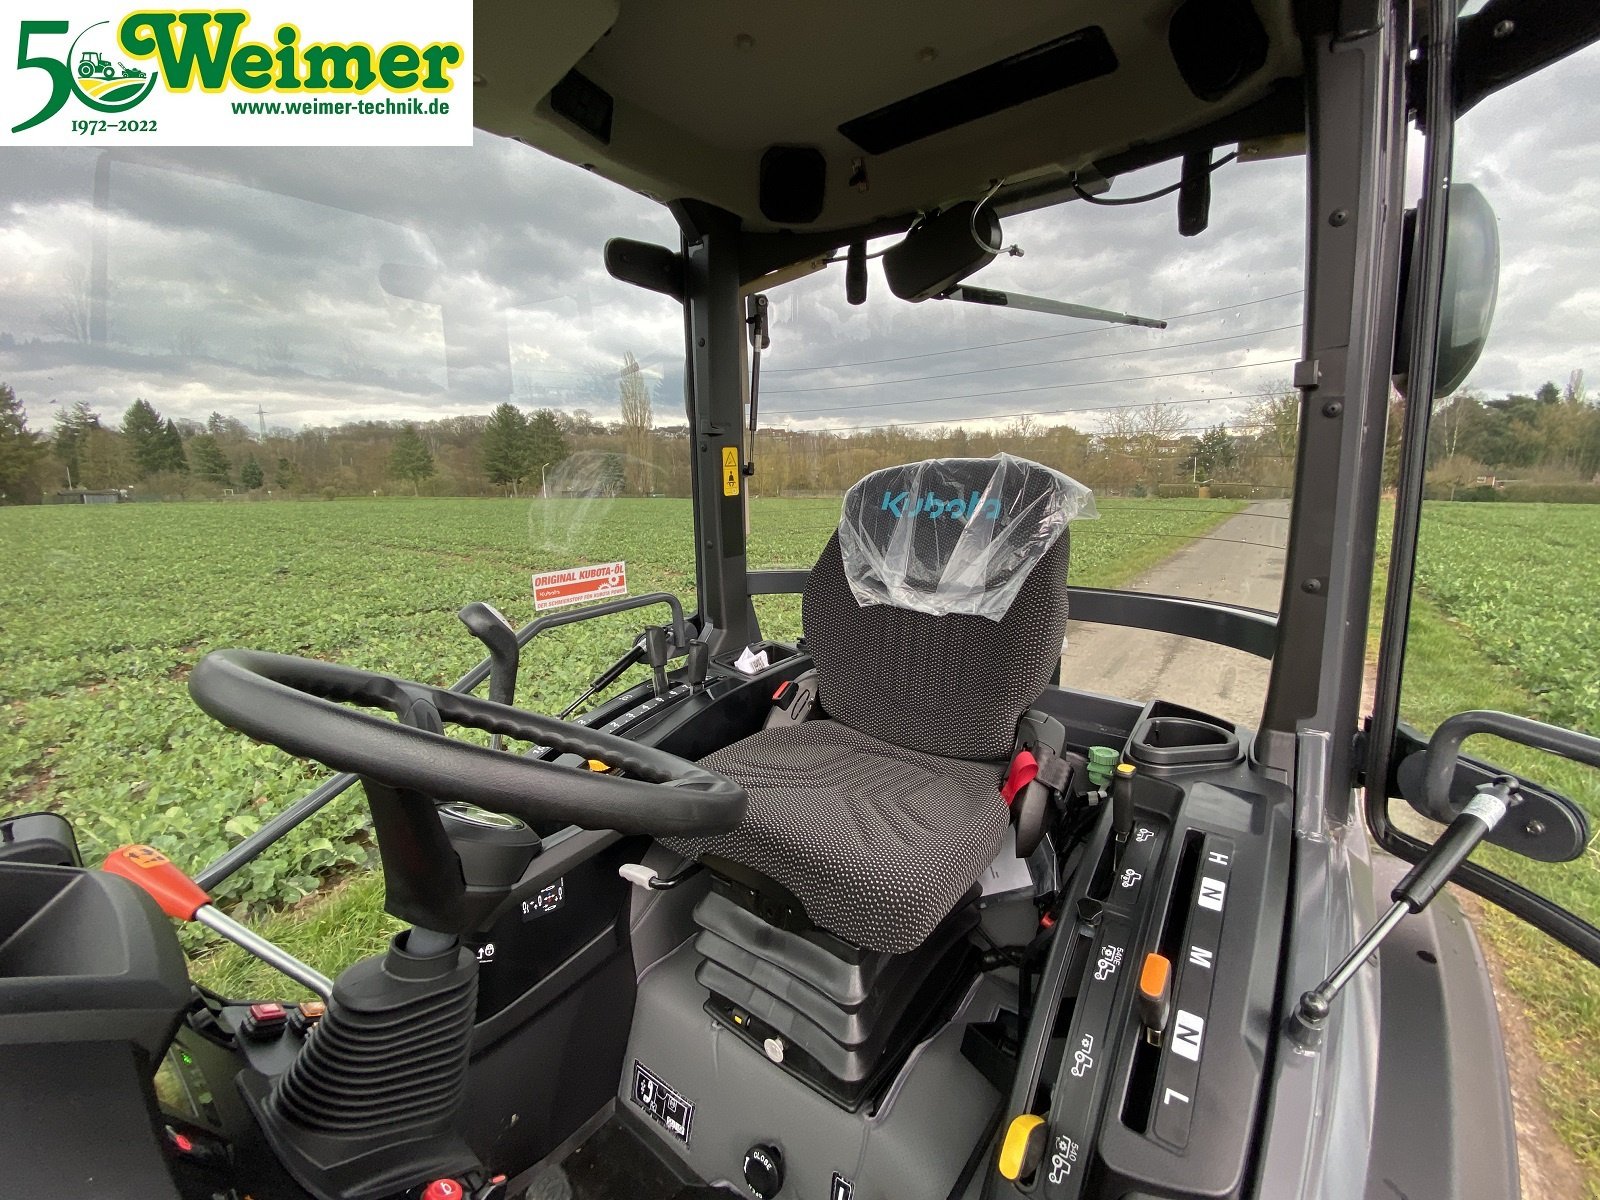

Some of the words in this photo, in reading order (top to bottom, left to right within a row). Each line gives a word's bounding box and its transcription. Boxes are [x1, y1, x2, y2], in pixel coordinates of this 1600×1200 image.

[881, 490, 1001, 519] Kubota
[535, 572, 577, 587] ORIGINAL
[579, 564, 624, 579] KUBOTA-ÖL
[1208, 851, 1229, 866] H
[1201, 886, 1222, 901] N
[1189, 945, 1213, 969] M
[1176, 1023, 1200, 1046] N
[1163, 1087, 1190, 1105] L
[1069, 1142, 1079, 1162] 540
